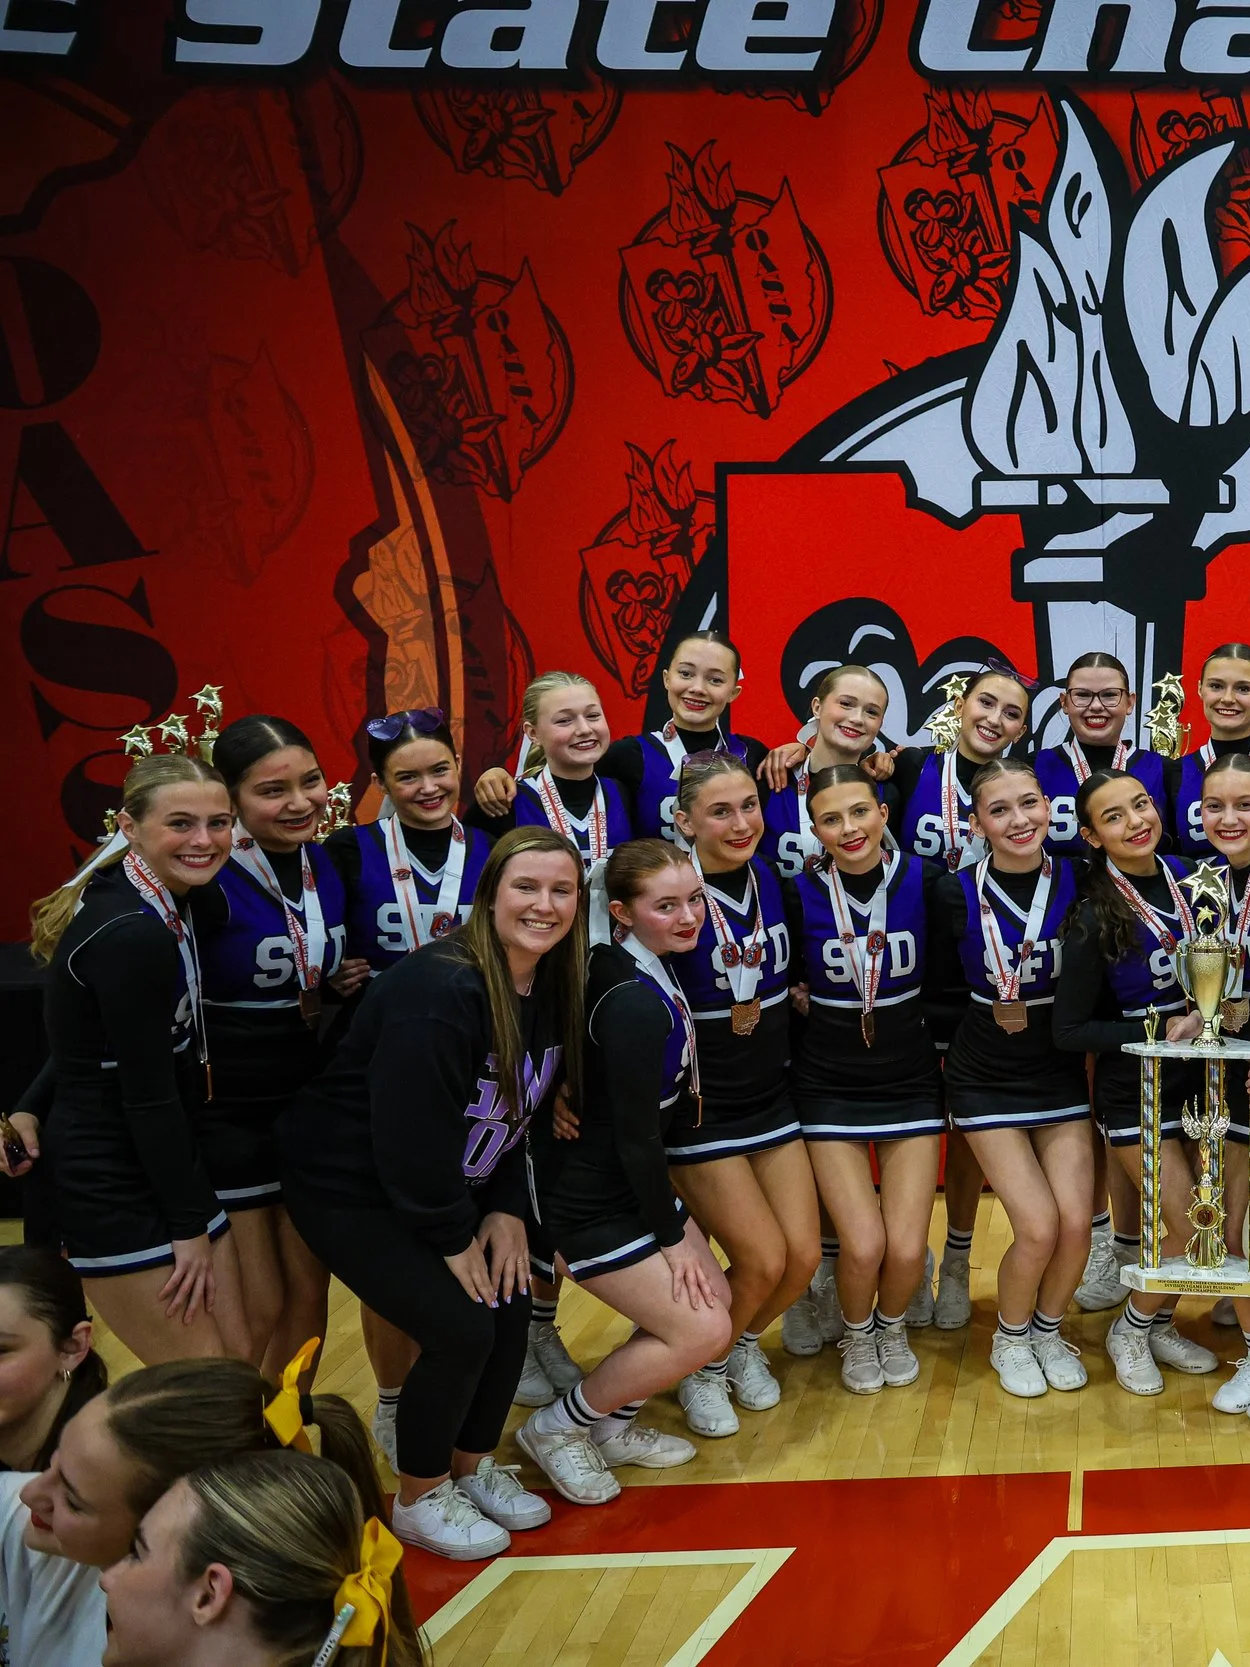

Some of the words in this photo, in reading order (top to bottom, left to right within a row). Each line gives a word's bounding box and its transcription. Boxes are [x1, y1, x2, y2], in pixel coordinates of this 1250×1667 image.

[745, 227, 801, 347] OASSA
[588, 812, 597, 863] CHAMPIO
[822, 930, 917, 984] SD
